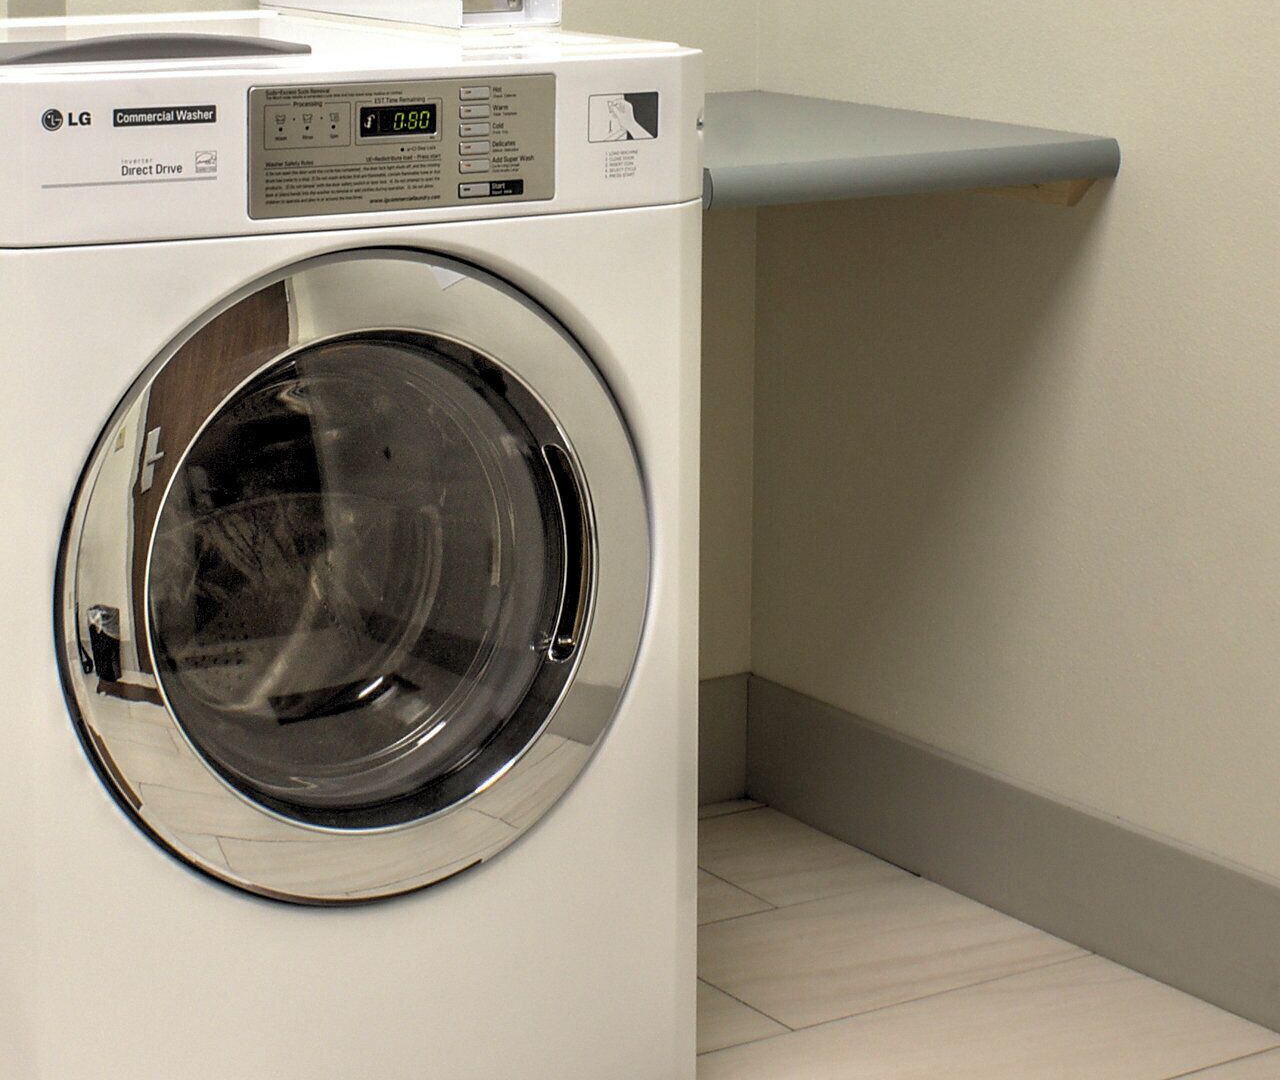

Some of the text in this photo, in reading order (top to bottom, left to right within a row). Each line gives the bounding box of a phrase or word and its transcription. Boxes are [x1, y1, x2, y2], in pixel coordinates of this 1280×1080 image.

[69, 112, 92, 127] LG
[116, 110, 214, 124] Commercial Washer
[122, 164, 183, 176] Direct Drive
